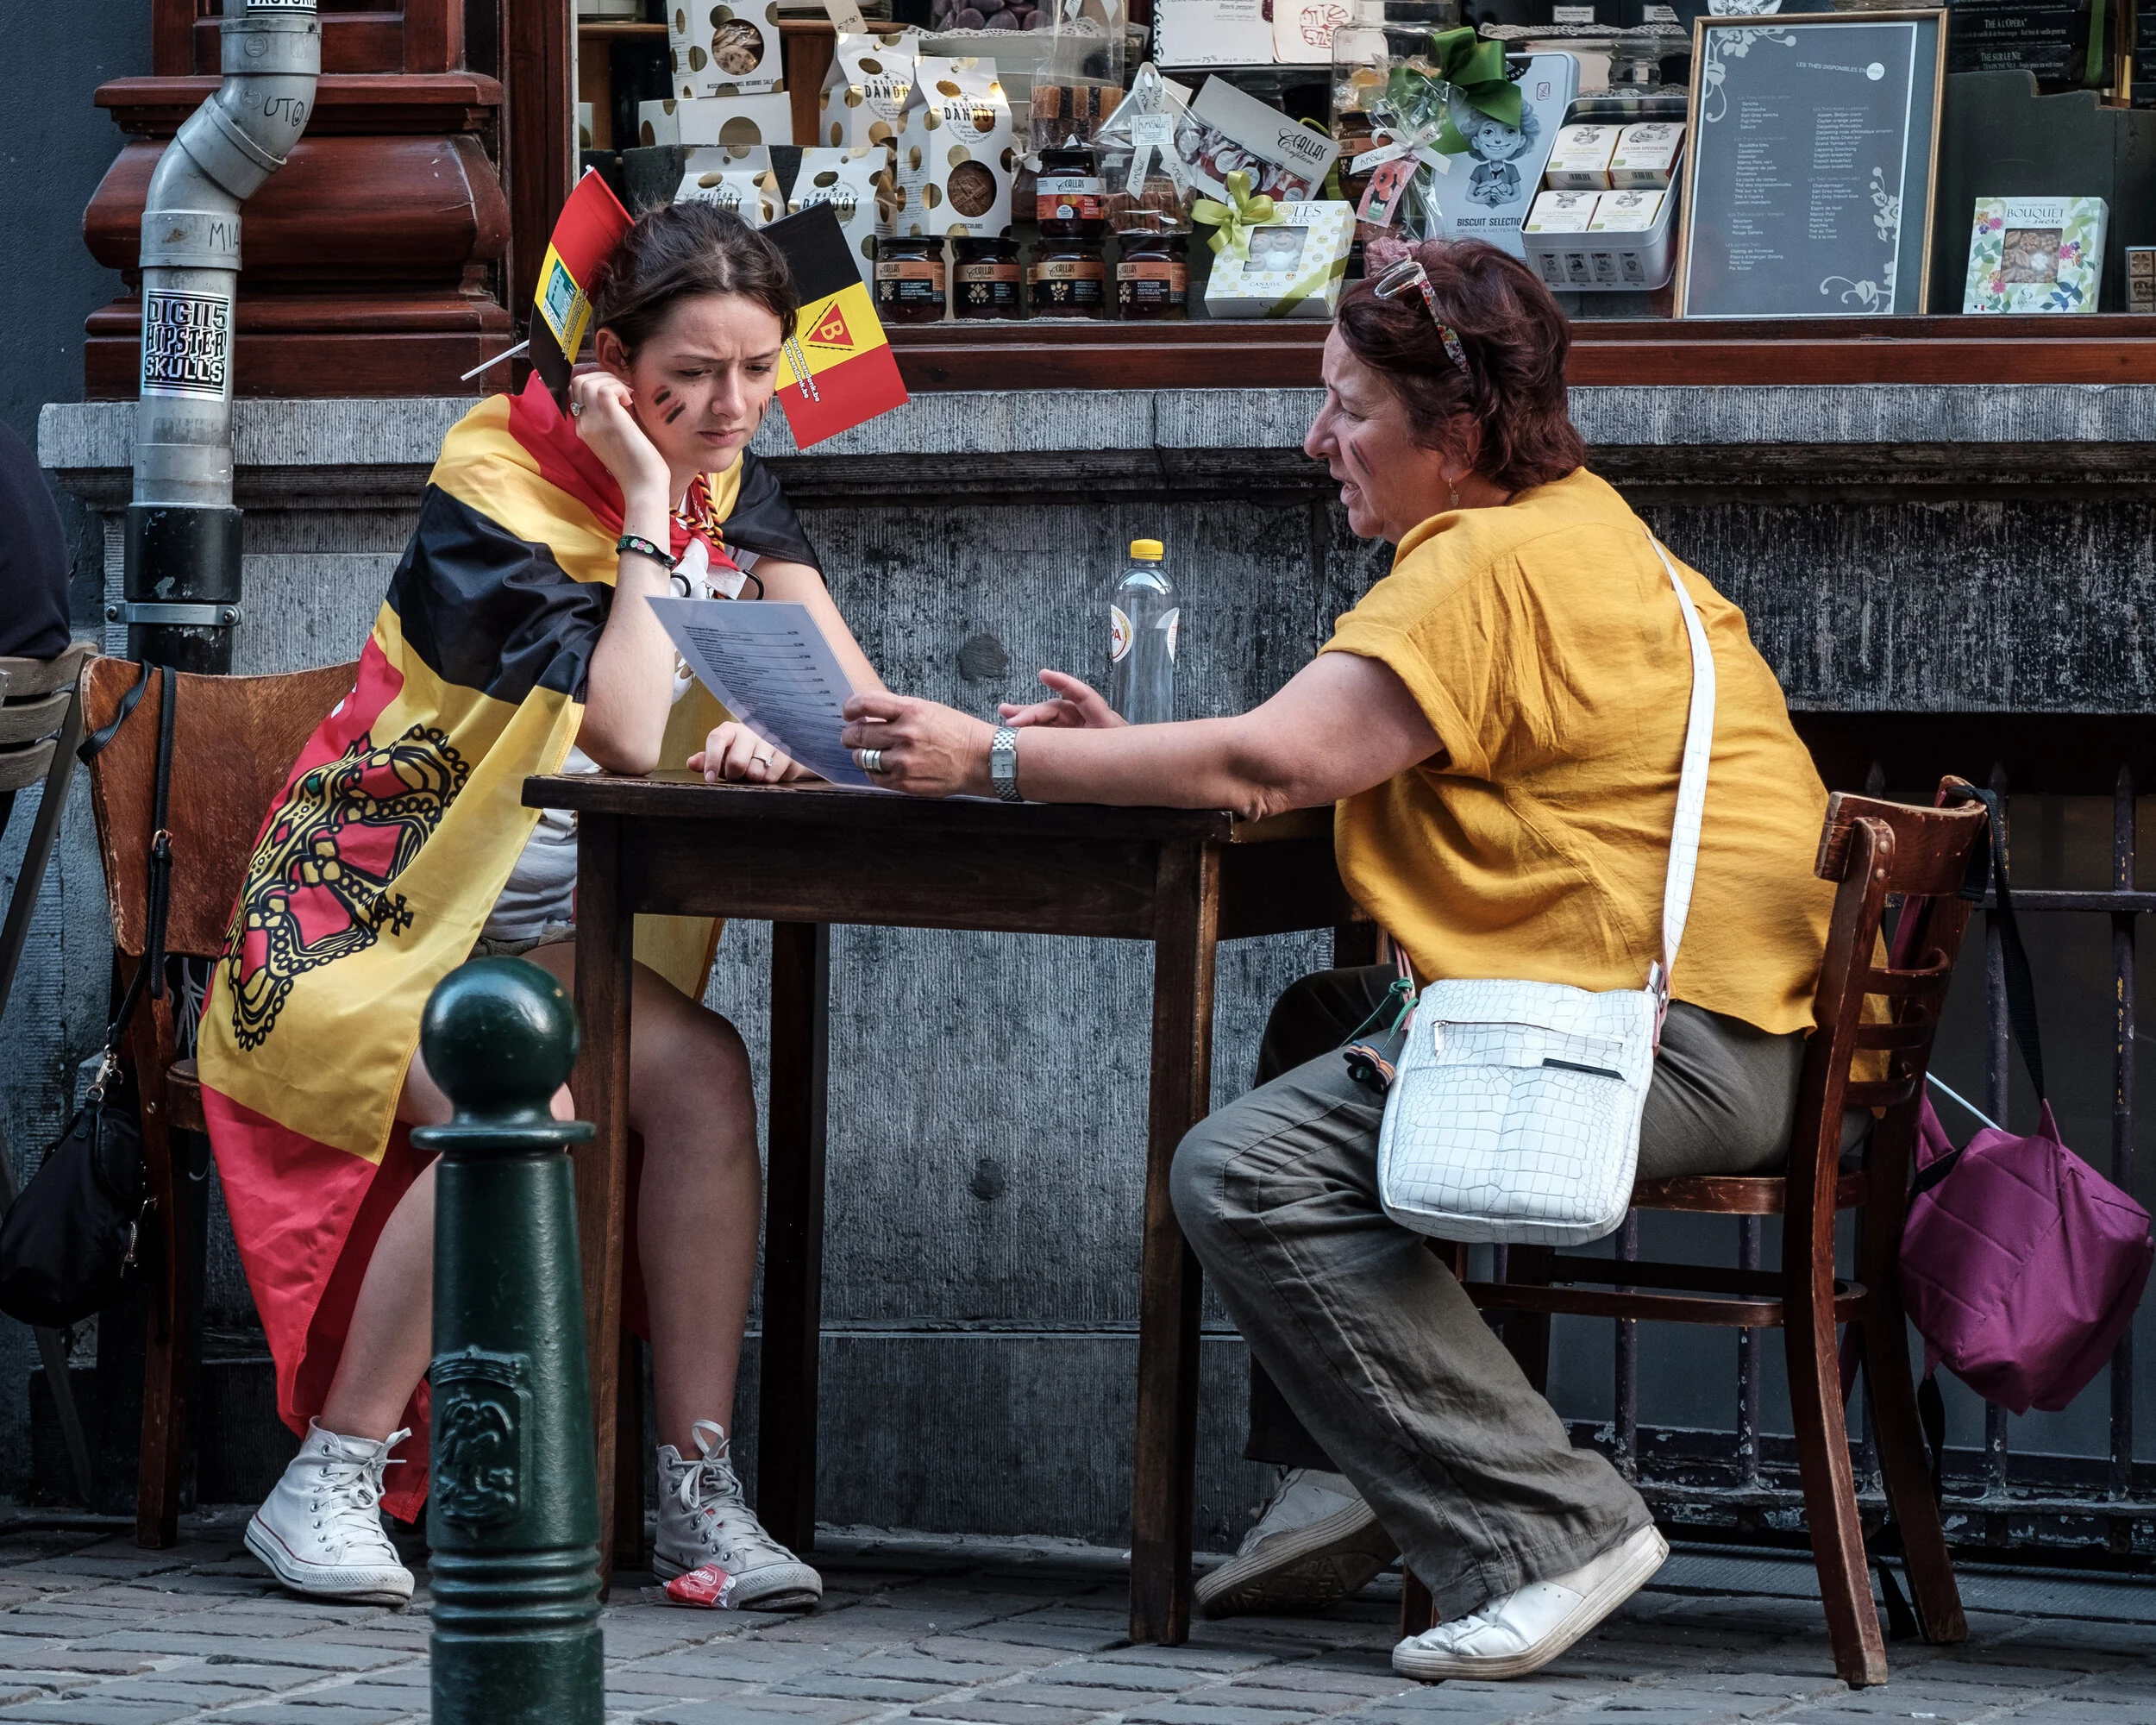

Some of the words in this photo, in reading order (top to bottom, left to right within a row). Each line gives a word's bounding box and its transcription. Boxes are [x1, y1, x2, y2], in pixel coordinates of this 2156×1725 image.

[865, 85, 909, 98] DANDO
[943, 107, 996, 122] DANDOY
[1293, 134, 1327, 161] CALLAS
[1065, 179, 1084, 188] CALLAS
[2007, 208, 2065, 220] BOUQUET
[1457, 217, 1487, 227] BISCUIT
[1489, 217, 1521, 226] SELECTIO
[883, 263, 899, 273] CALLAS
[975, 266, 994, 275] CALLAS
[1056, 264, 1075, 273] CALLAS
[820, 320, 843, 341] B
[146, 323, 227, 357] HIPSTER
[145, 355, 223, 383] SKULLS
[783, 342, 809, 399] rtbreendonk.be
[1111, 629, 1122, 641] PA
